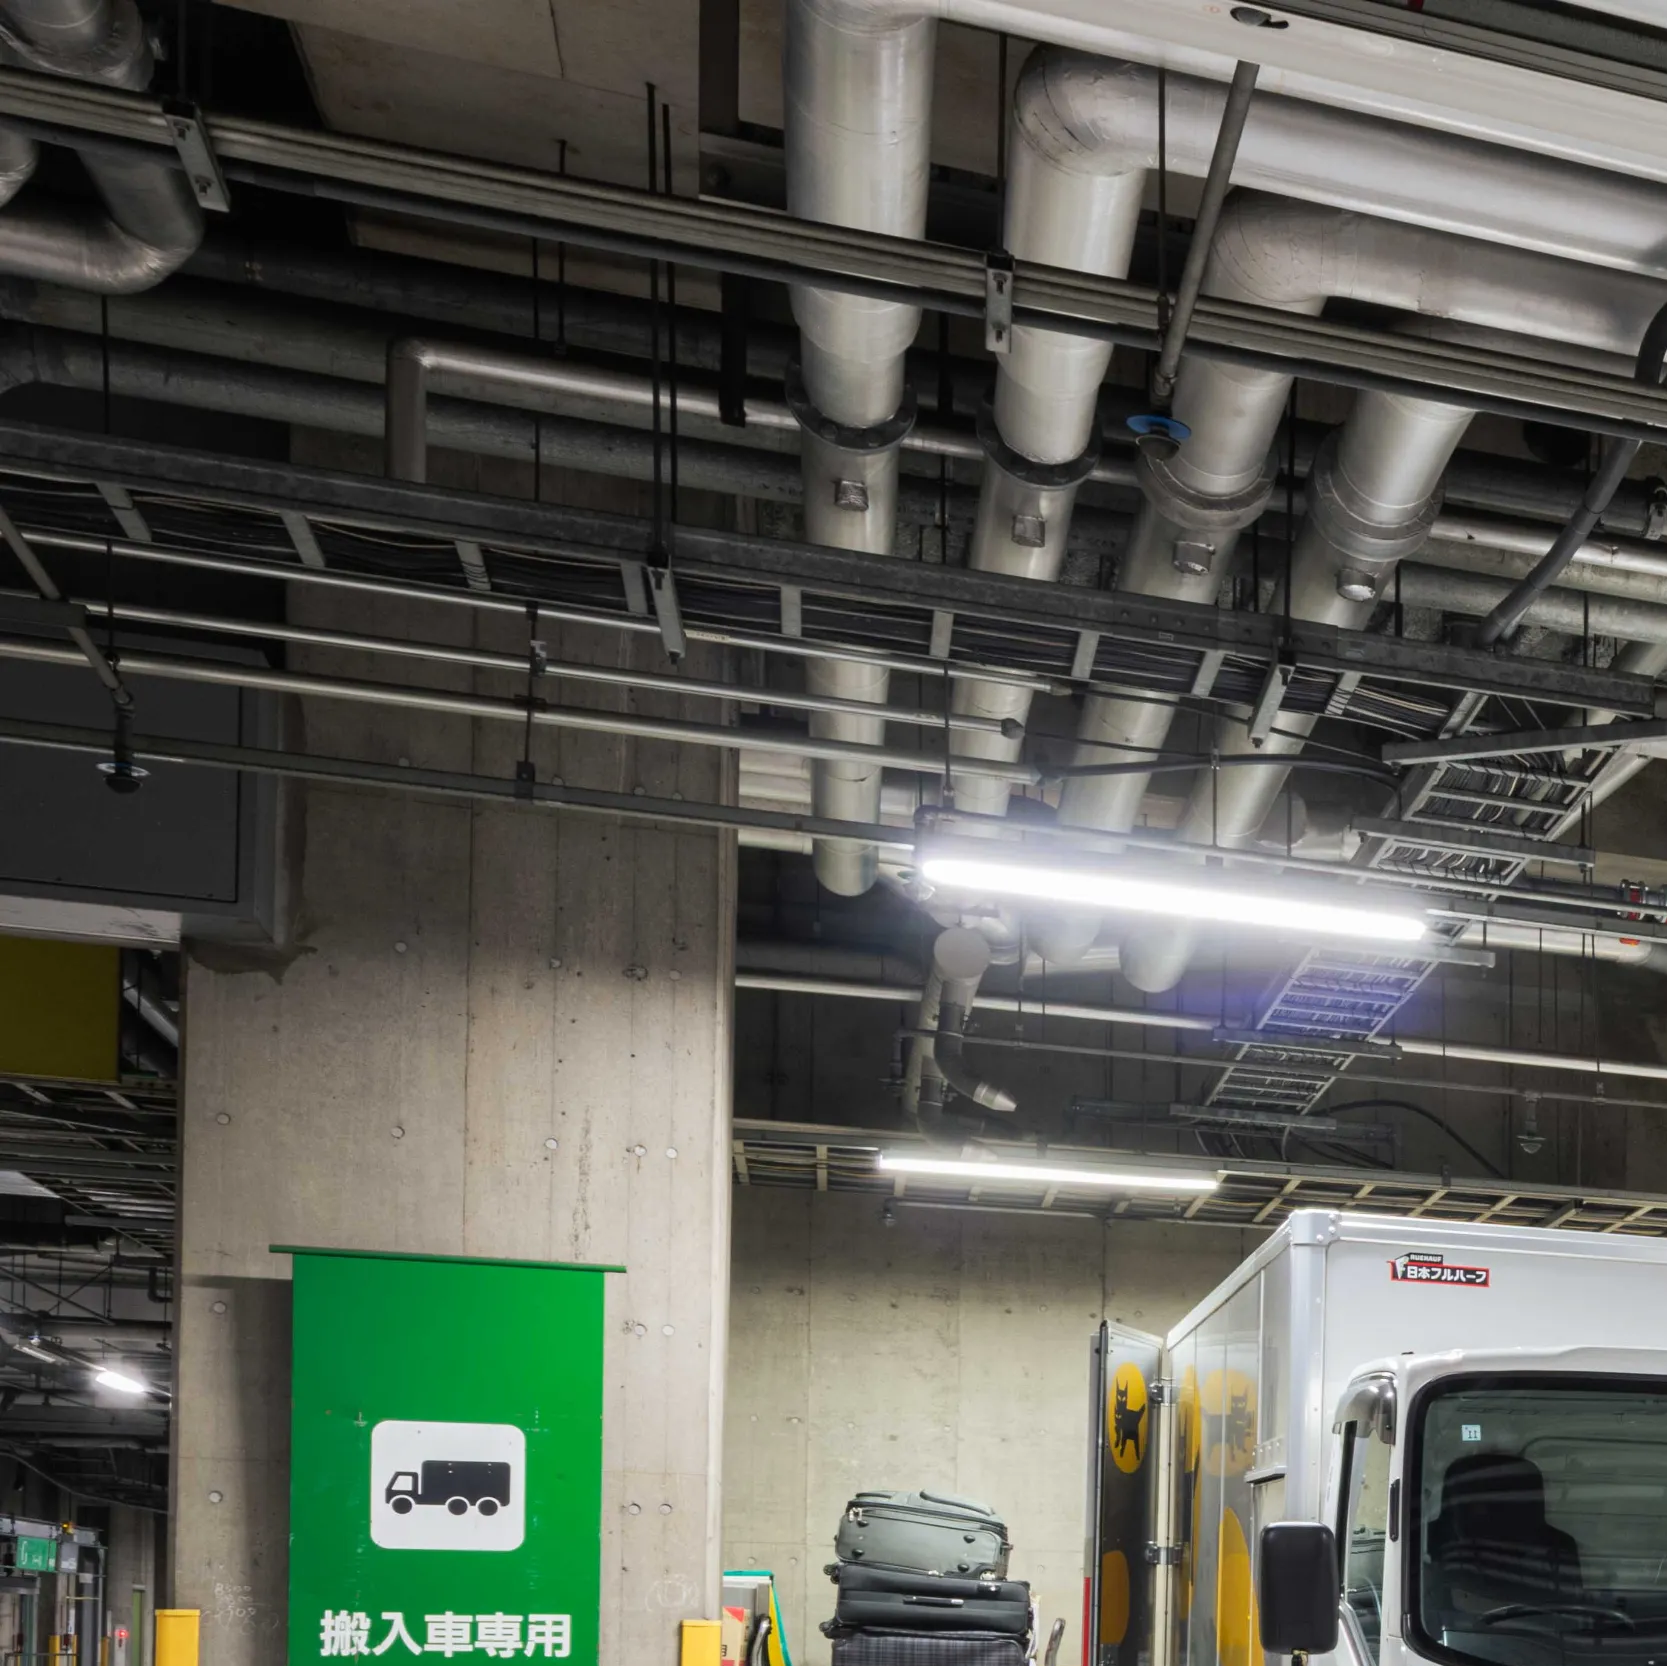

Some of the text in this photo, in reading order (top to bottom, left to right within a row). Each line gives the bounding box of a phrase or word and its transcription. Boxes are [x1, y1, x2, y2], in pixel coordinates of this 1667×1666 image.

[1407, 1266, 1487, 1283] 日本フルハーフ
[319, 1609, 572, 1658] 搬入車専用
